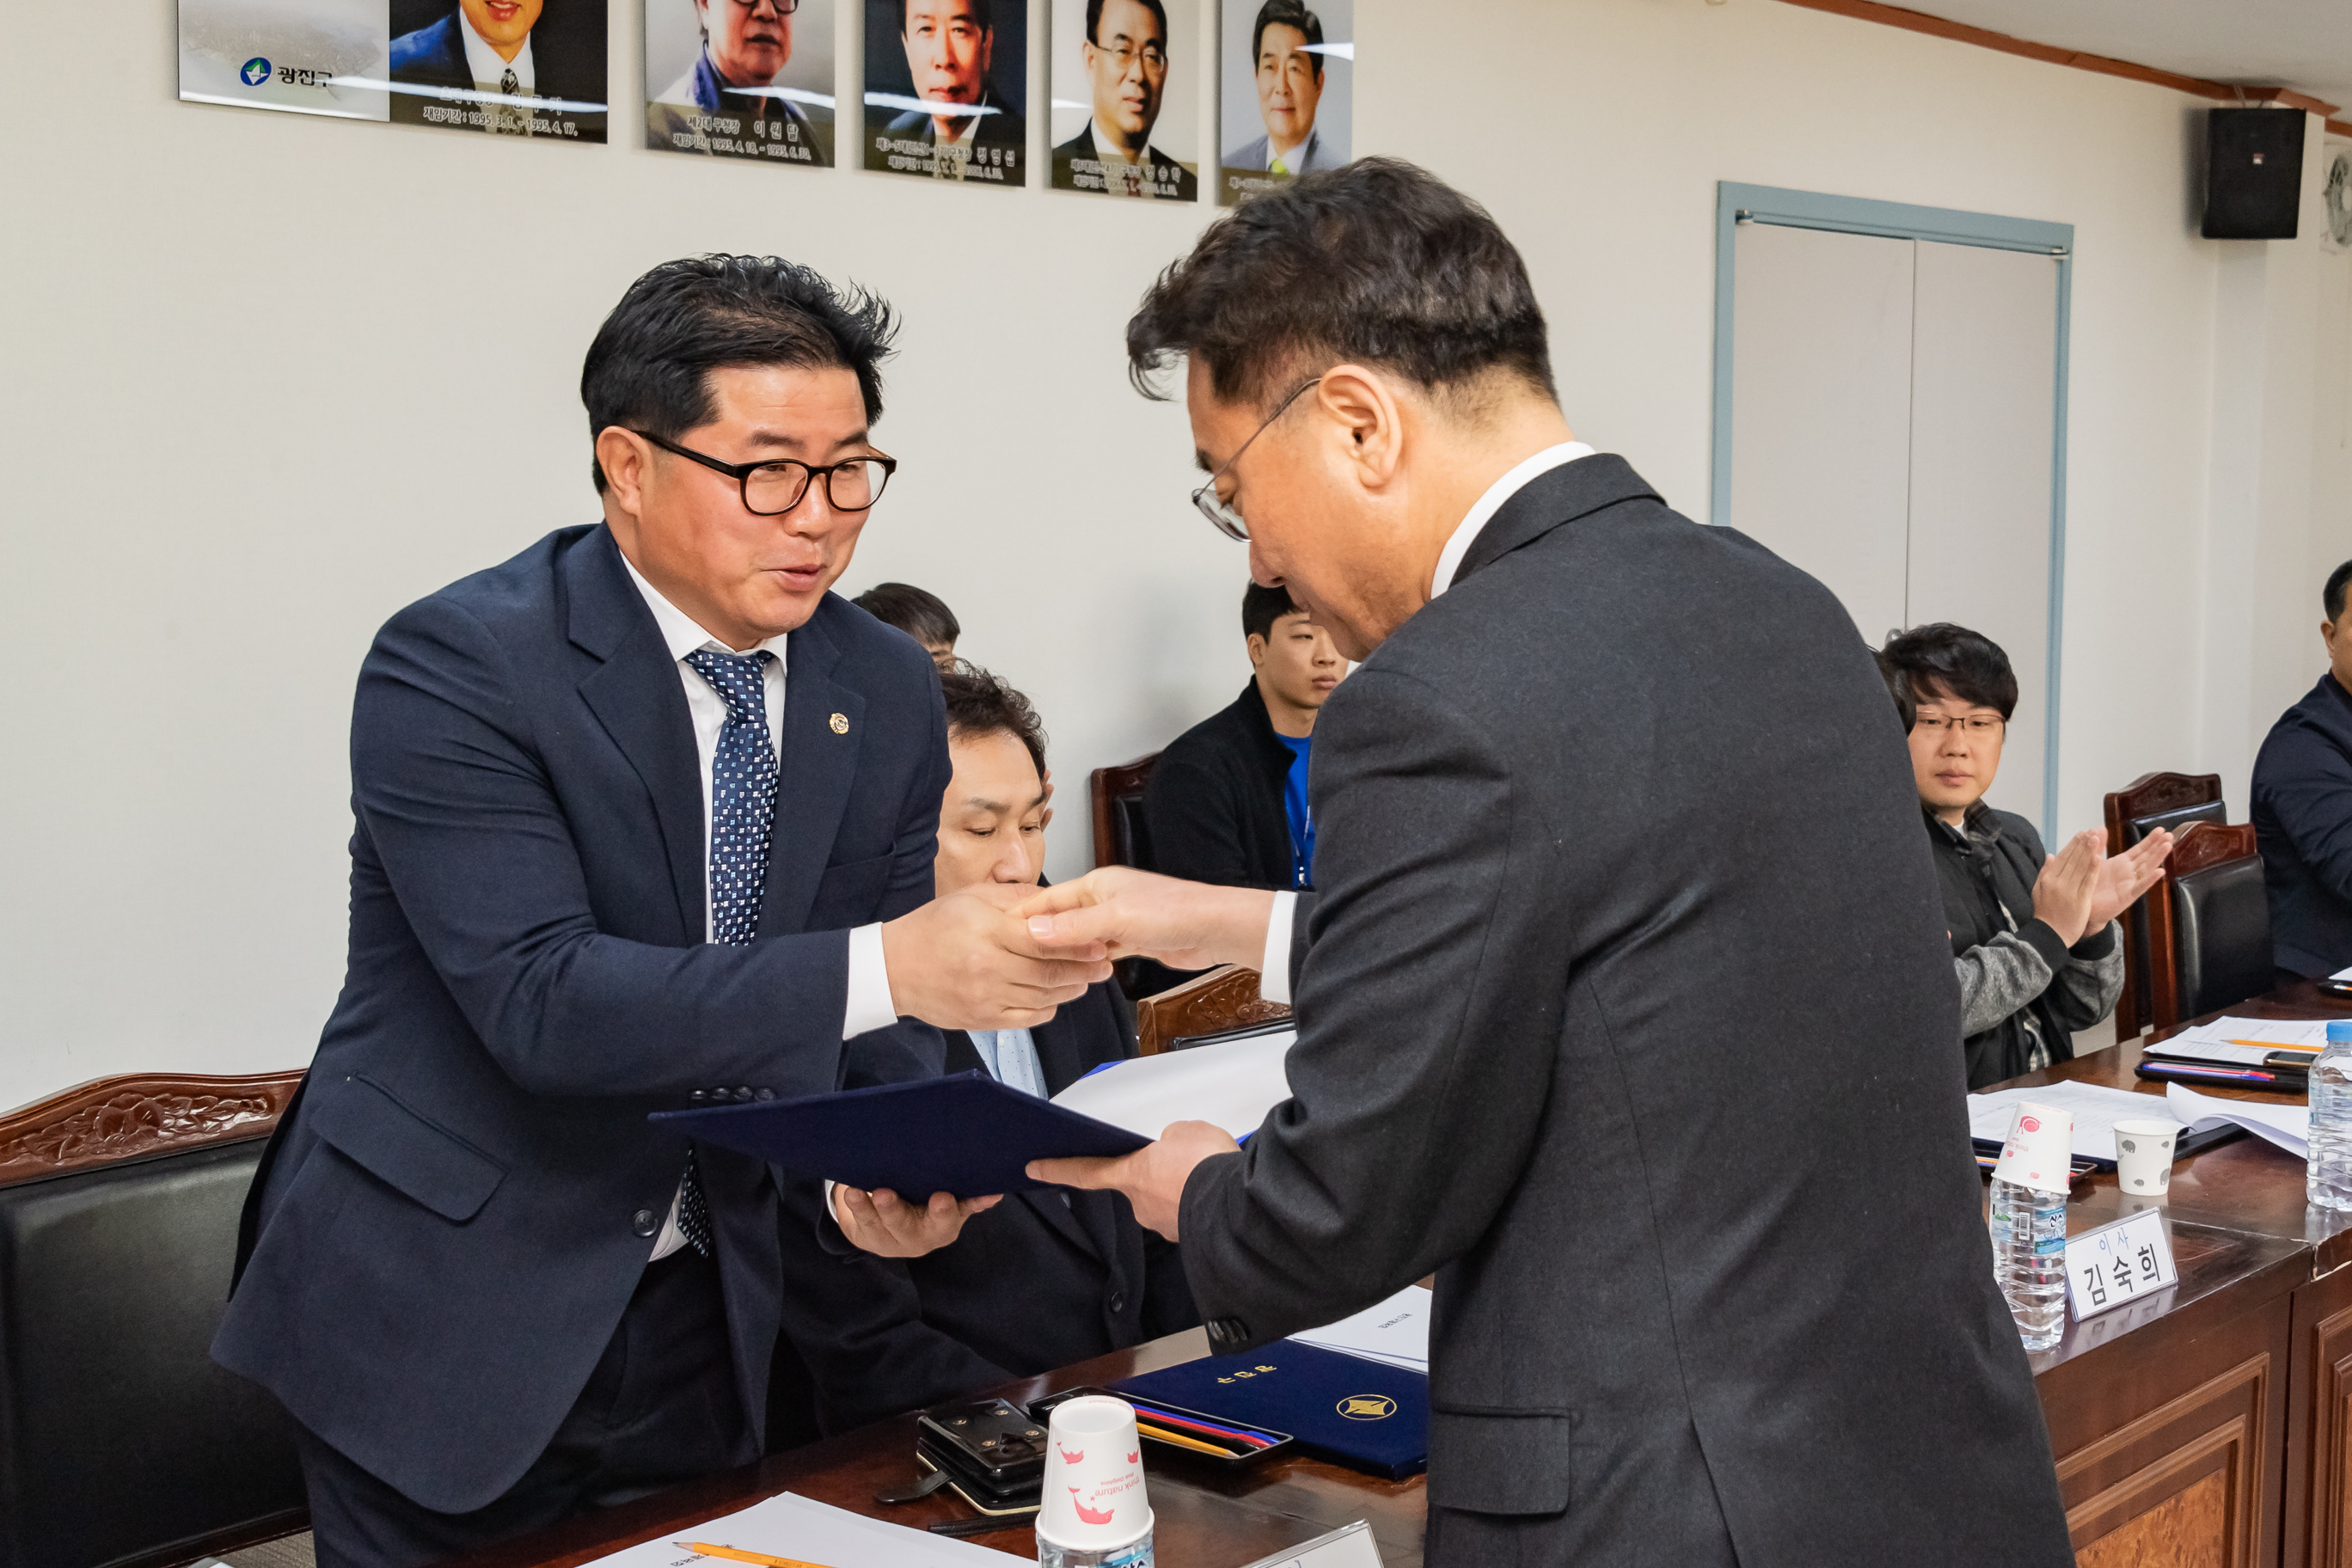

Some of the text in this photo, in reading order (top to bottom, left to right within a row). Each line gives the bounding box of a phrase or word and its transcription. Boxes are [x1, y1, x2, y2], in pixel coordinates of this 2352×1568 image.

[277, 66, 333, 88] 광진구
[2083, 1243, 2160, 1307] 김숙희
[1094, 1475, 1140, 1497] think nature
